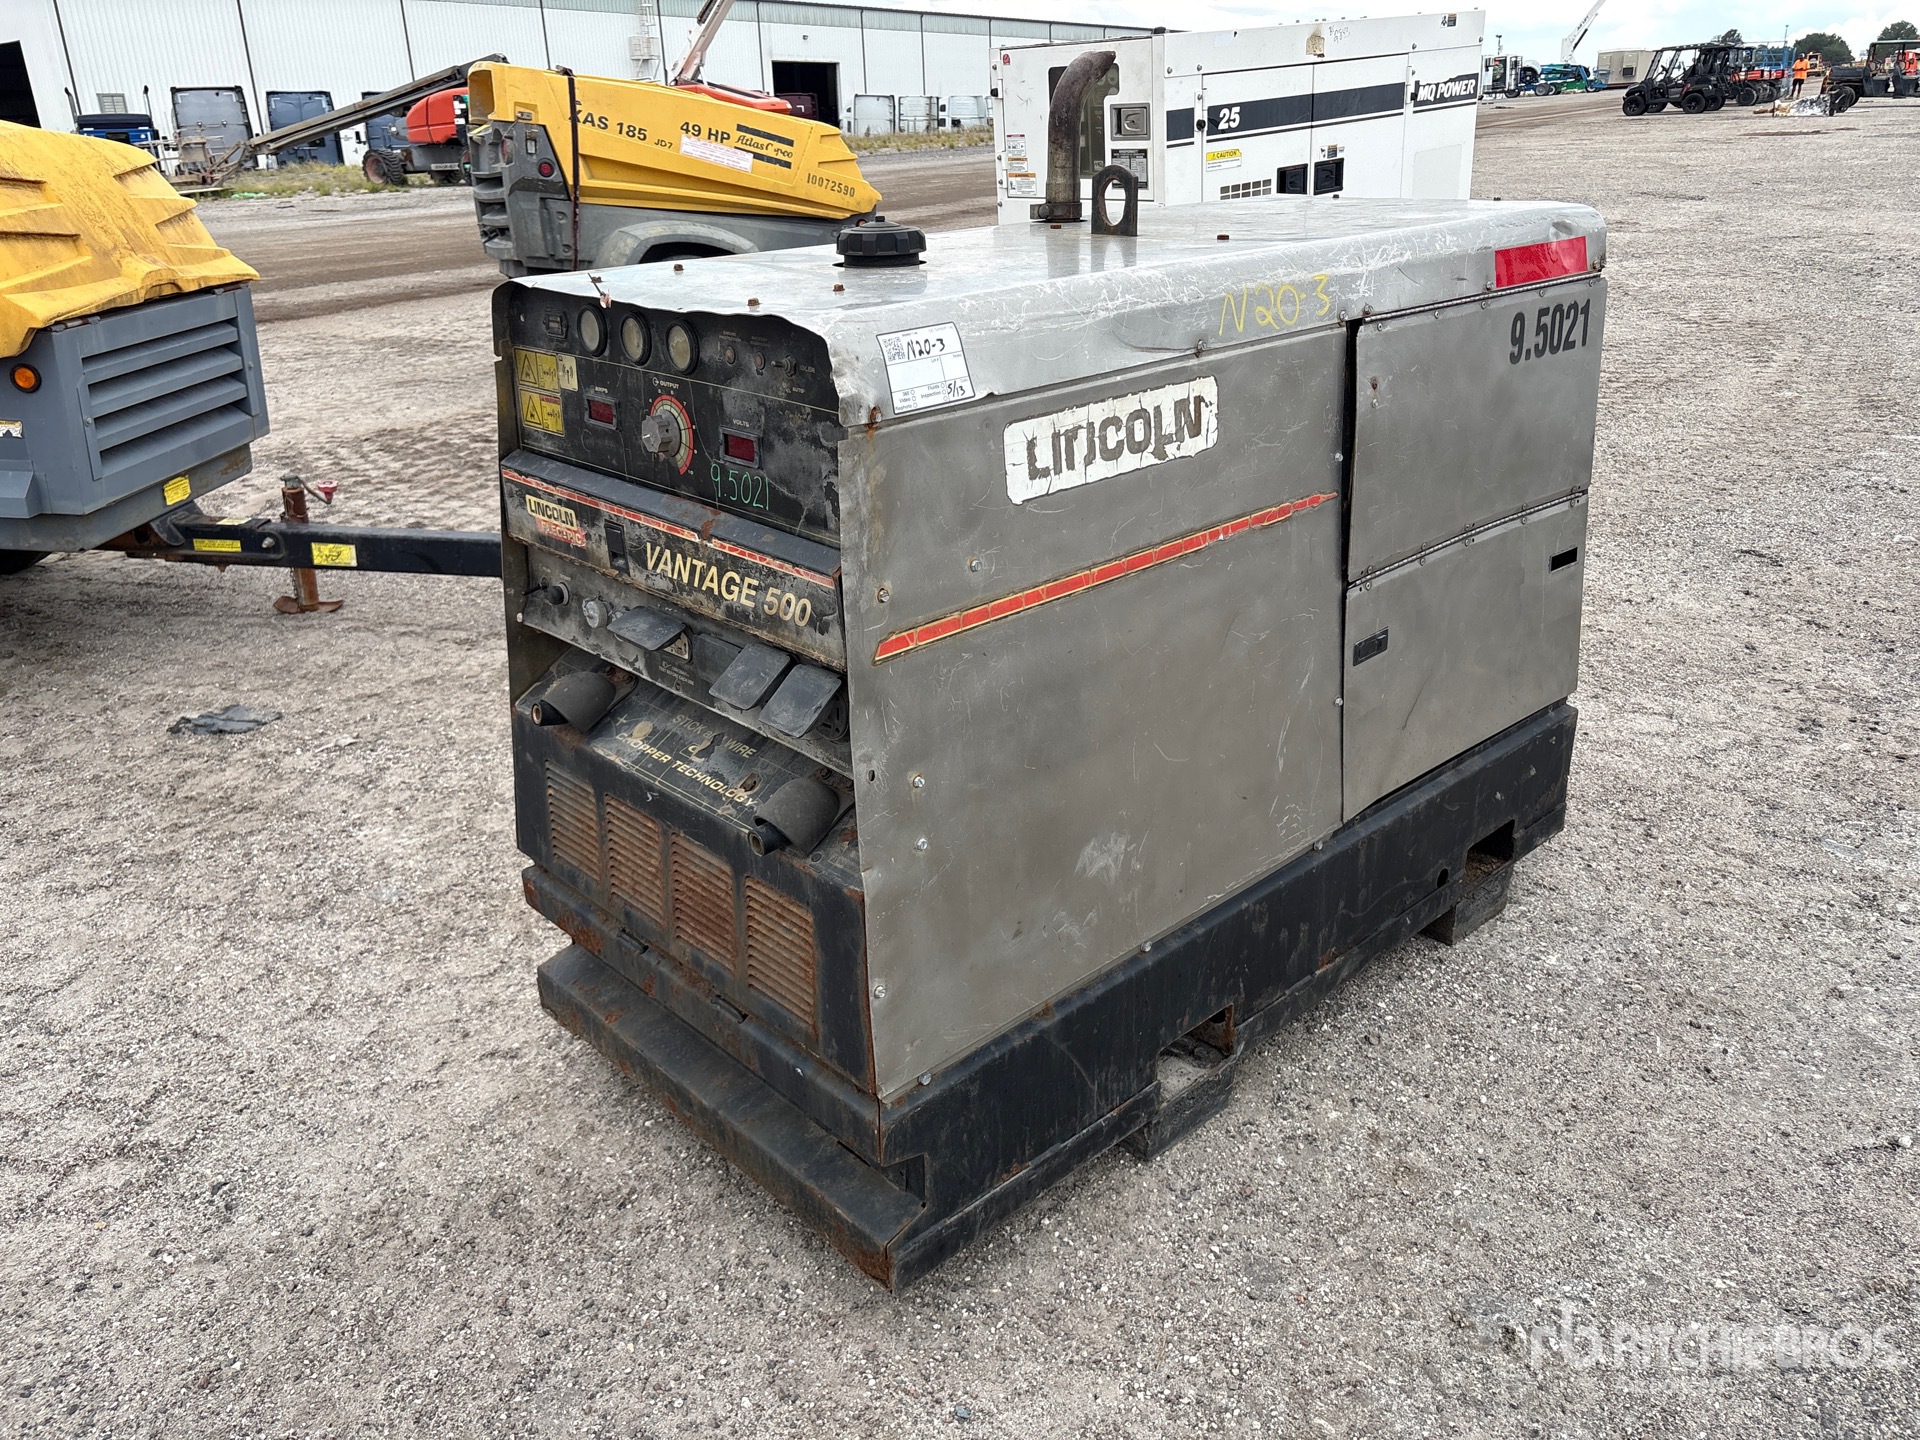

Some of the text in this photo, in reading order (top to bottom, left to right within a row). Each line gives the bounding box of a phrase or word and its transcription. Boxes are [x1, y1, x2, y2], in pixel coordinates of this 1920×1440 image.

[1417, 78, 1476, 102] MQ POWER
[1218, 106, 1241, 130] 25
[616, 121, 648, 142] 185
[654, 138, 674, 149] JD7
[680, 121, 731, 144] 49 HP
[735, 135, 765, 151] Atlas
[765, 139, 794, 158] Cpco
[1216, 151, 1237, 159] CAUTION
[806, 172, 856, 198] 10072590
[1508, 298, 1592, 365] 9.5021
[907, 338, 946, 360] N20-3
[660, 381, 680, 389] OUTPUT
[947, 380, 966, 397] 5/13
[732, 419, 750, 428] VOLTS
[710, 464, 771, 511] 9.5021
[528, 498, 574, 527] LINCOLN
[646, 541, 812, 627] VANTAGE 500
[672, 714, 705, 736] STICK
[725, 738, 757, 759] WIRE
[671, 759, 758, 807] TECHNOLOGY
